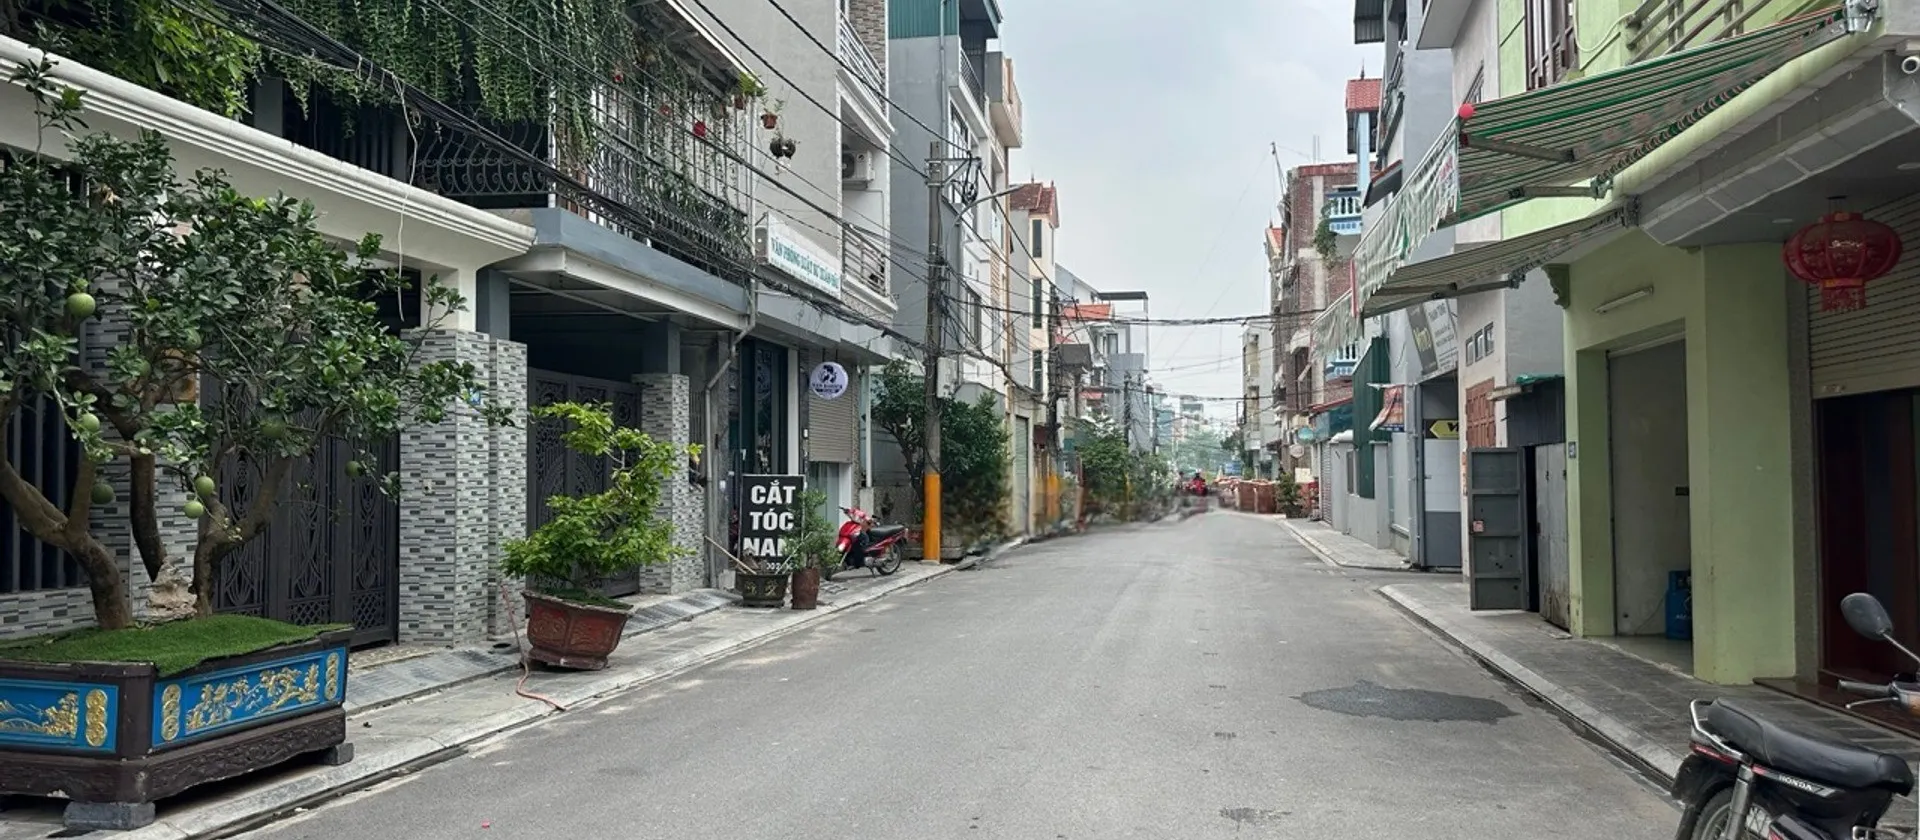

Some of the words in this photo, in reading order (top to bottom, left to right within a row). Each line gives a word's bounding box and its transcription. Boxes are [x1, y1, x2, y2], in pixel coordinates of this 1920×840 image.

[751, 479, 796, 505] CẮT
[749, 507, 795, 531] TÓC
[1779, 774, 1812, 791] HONDA
